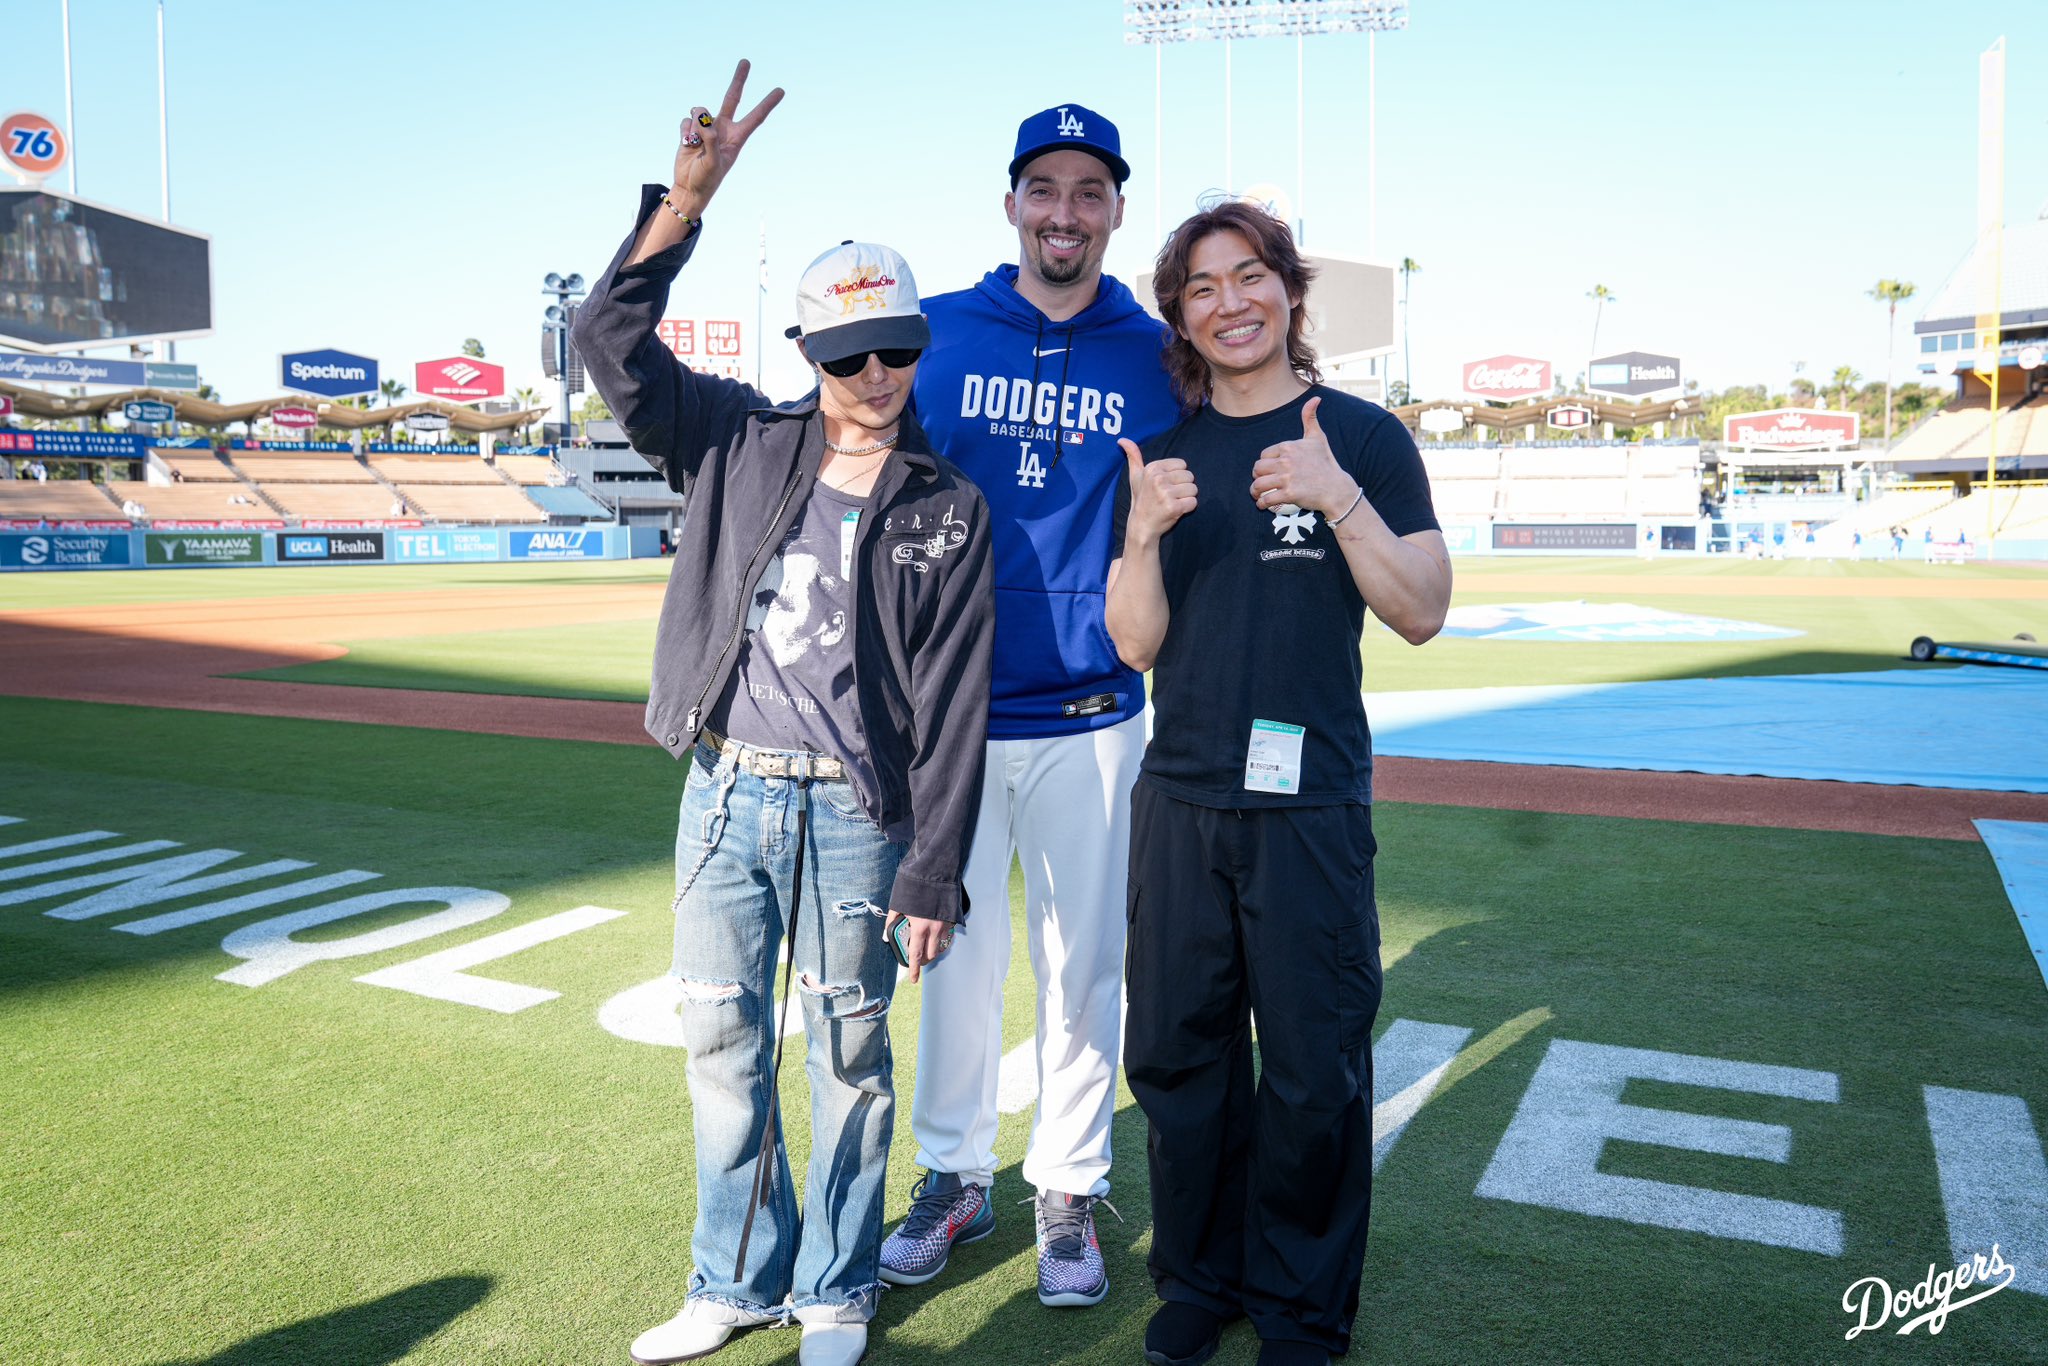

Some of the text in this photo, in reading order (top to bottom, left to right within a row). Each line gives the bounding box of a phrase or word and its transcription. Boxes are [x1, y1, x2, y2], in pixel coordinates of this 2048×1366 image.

[1057, 107, 1085, 137] LA
[11, 128, 55, 160] 76
[707, 323, 736, 339] UNI
[707, 338, 739, 355] QLO
[291, 362, 366, 381] Spectrum
[1630, 365, 1675, 380] Health
[960, 374, 1125, 436] DODGERS
[35, 434, 81, 444] UNIQLO
[85, 436, 116, 444] FIELD
[1737, 425, 1845, 444] Budweiser
[35, 443, 136, 454] DODGER STADIUM
[264, 441, 305, 449] UNIQLO
[1016, 441, 1046, 488] LA
[53, 535, 108, 551] Security
[290, 539, 376, 554] UCLA Health
[398, 535, 446, 557] TEL
[452, 534, 480, 543] TOKYO
[528, 533, 566, 549] ANA
[454, 543, 496, 552] ELECTRON
[54, 550, 102, 564] Benefit
